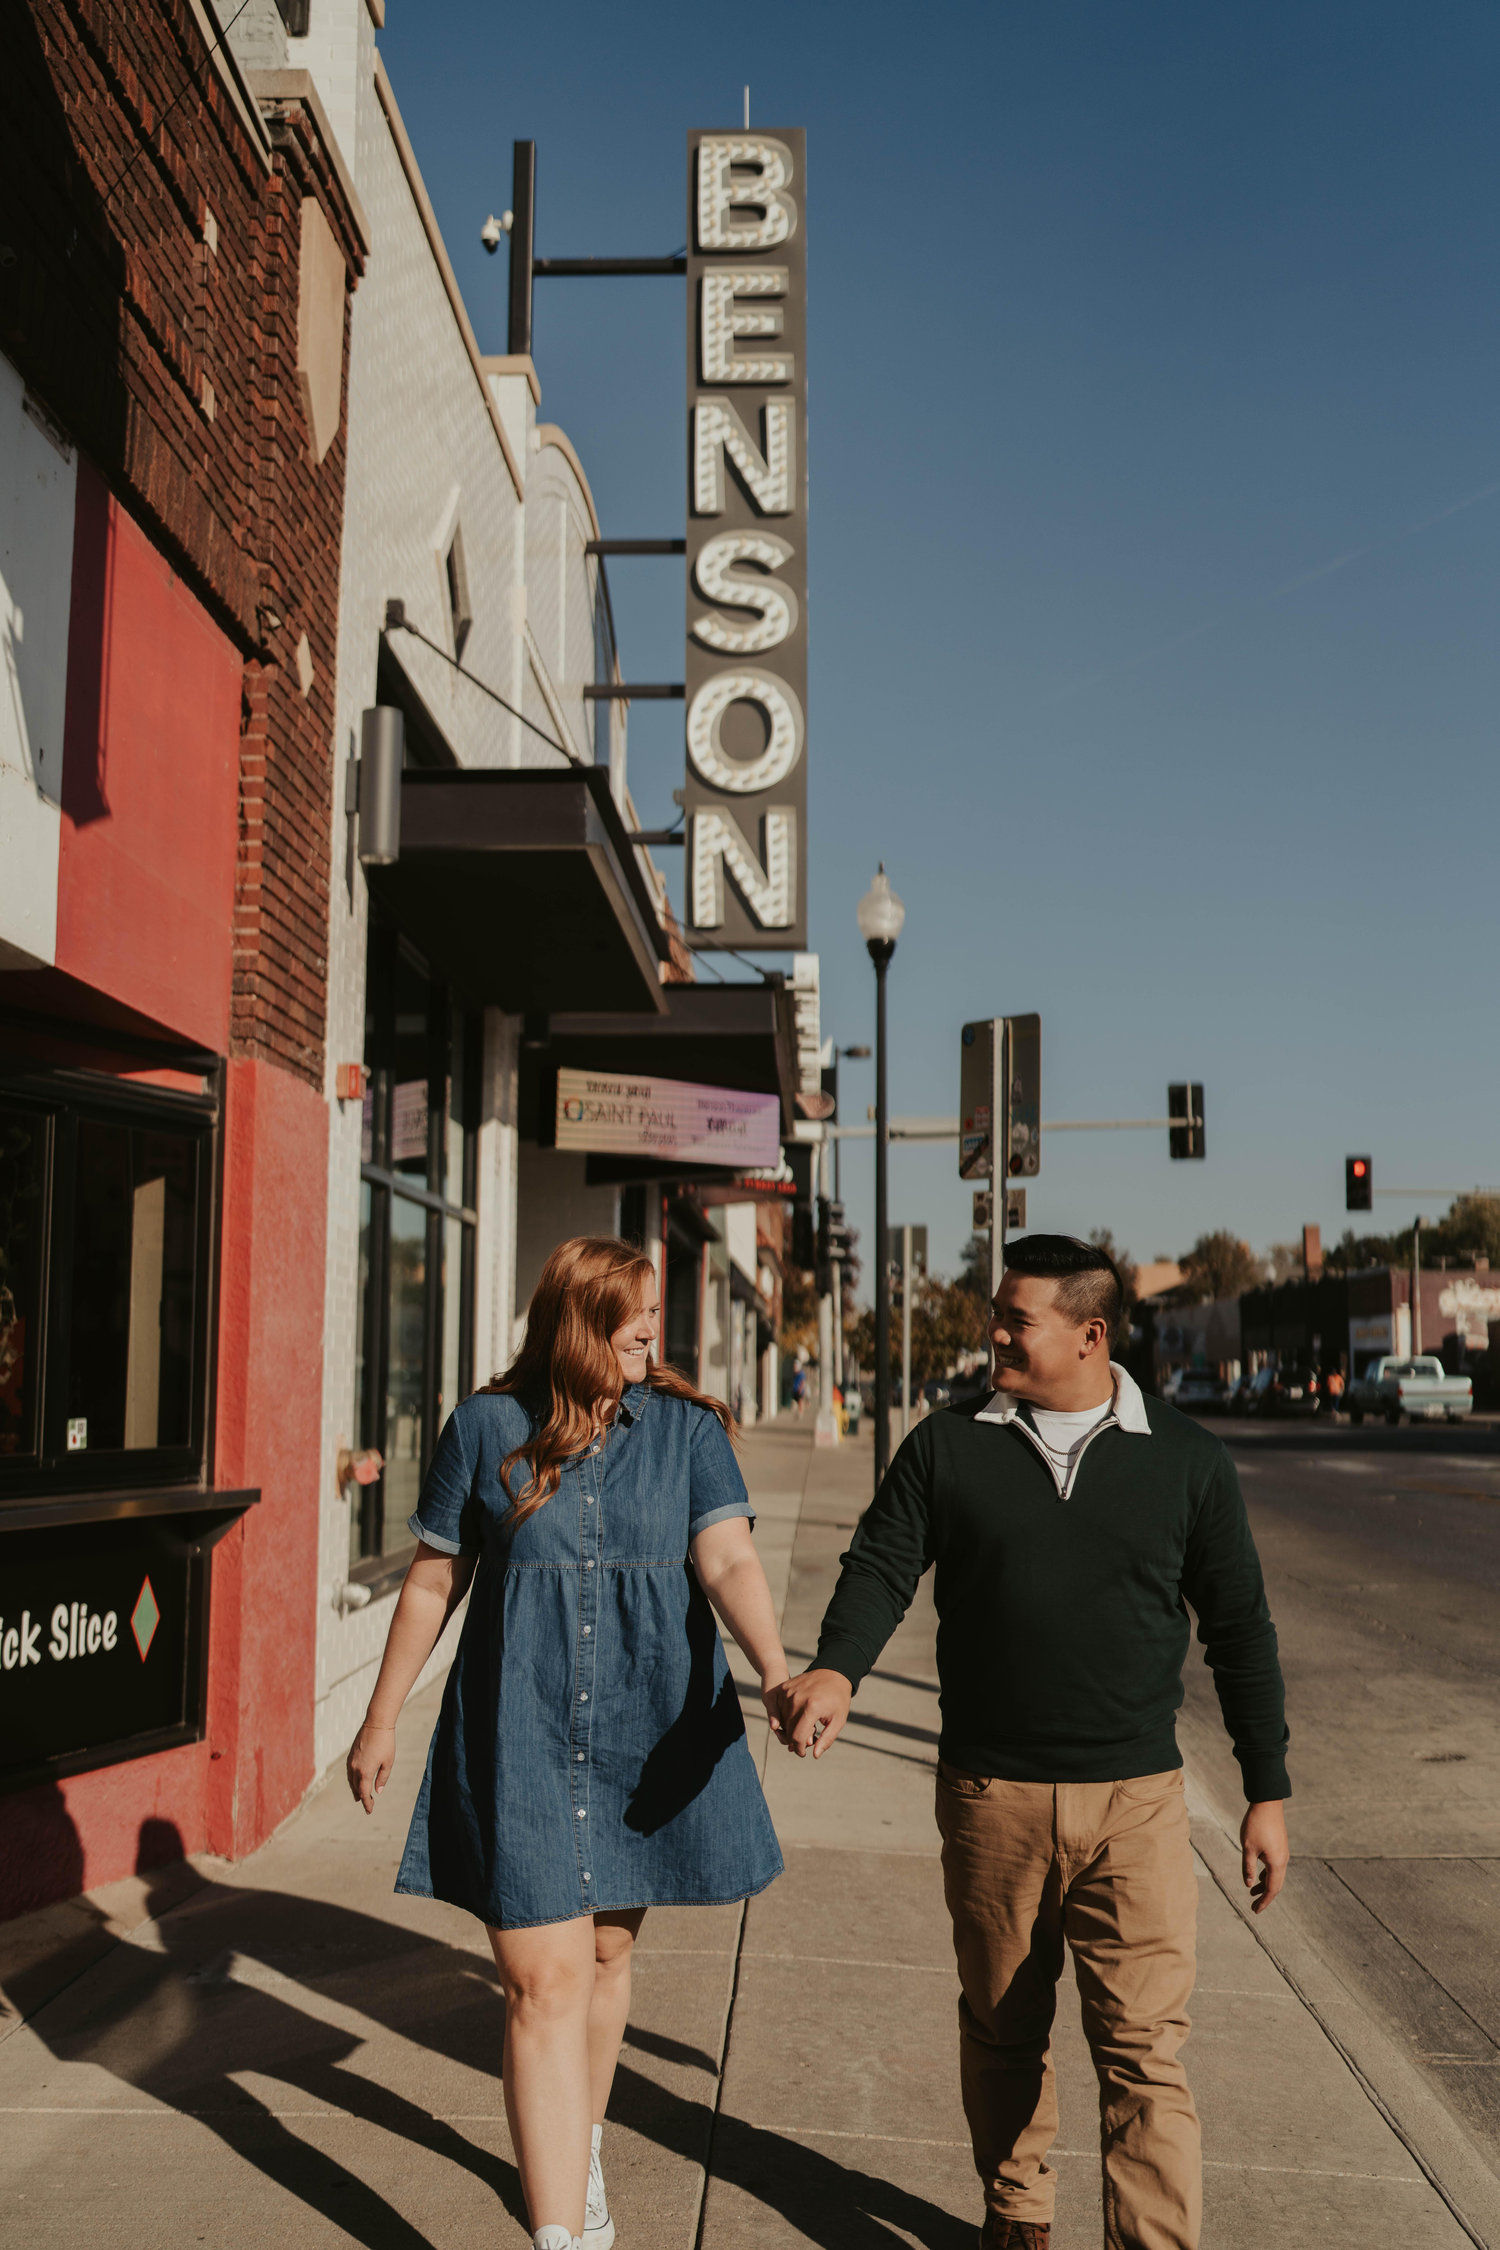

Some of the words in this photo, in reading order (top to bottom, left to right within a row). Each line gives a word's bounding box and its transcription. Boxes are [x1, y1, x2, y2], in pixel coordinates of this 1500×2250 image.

[686, 135, 804, 928] BENSON
[585, 1101, 633, 1125] SAINT
[638, 1106, 677, 1129] PAUL
[48, 1601, 118, 1661] Slice
